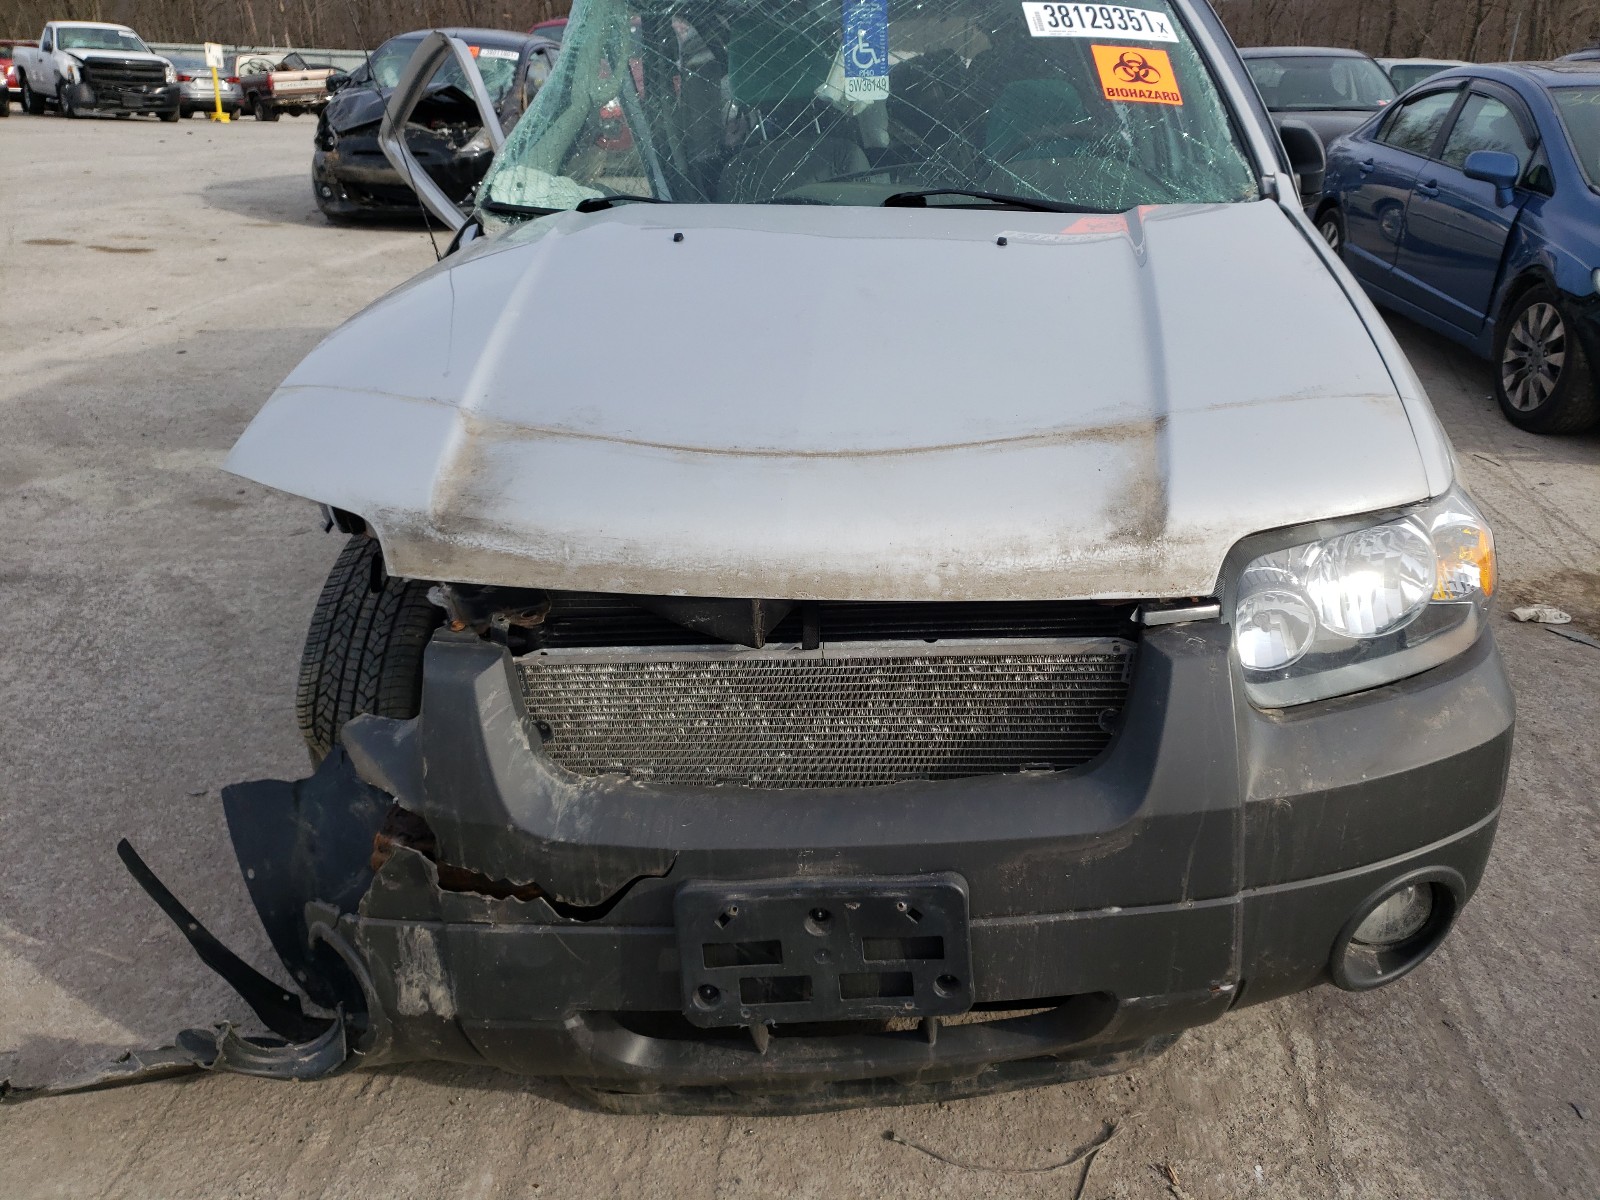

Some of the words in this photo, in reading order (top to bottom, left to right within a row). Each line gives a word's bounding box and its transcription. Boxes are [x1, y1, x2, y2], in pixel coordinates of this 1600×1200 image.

[1043, 4, 1155, 33] 38129351
[848, 77, 887, 93] 5W36149
[1106, 87, 1180, 102] BIOHAZARD
